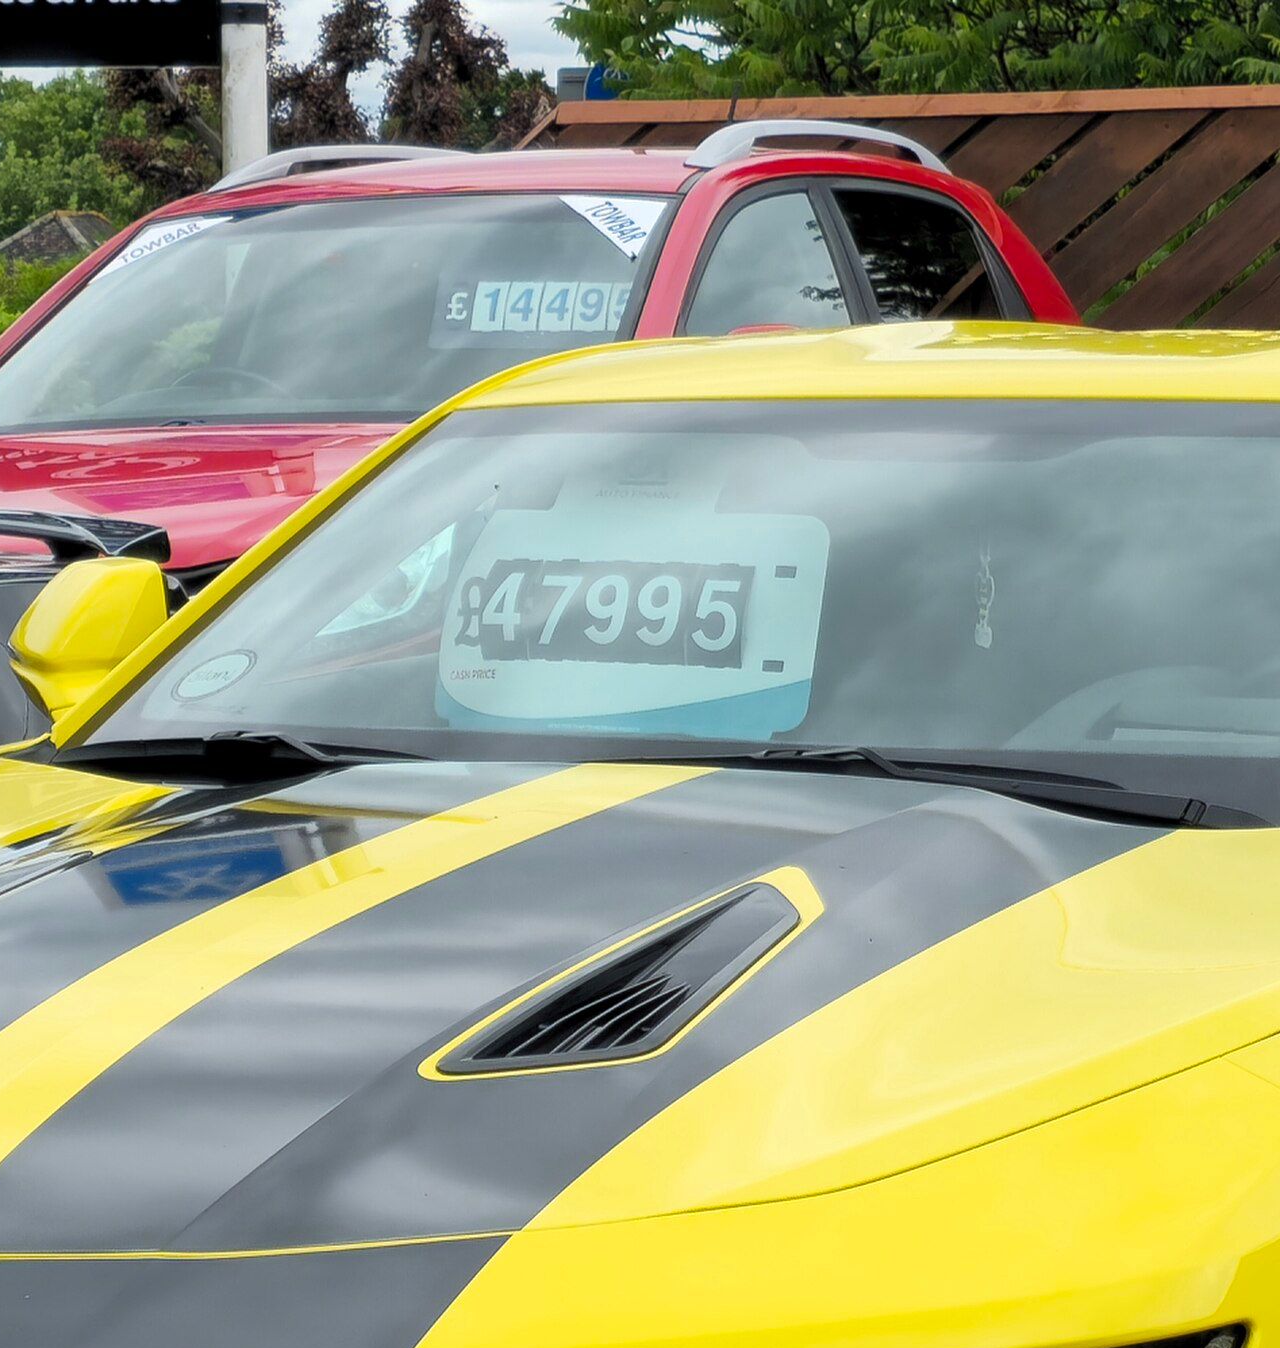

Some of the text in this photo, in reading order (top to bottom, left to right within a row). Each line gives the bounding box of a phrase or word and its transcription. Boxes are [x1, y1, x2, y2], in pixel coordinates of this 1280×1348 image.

[121, 223, 201, 263] TOWBAR
[584, 201, 647, 244] TOWBAR
[453, 571, 742, 652] £47995
